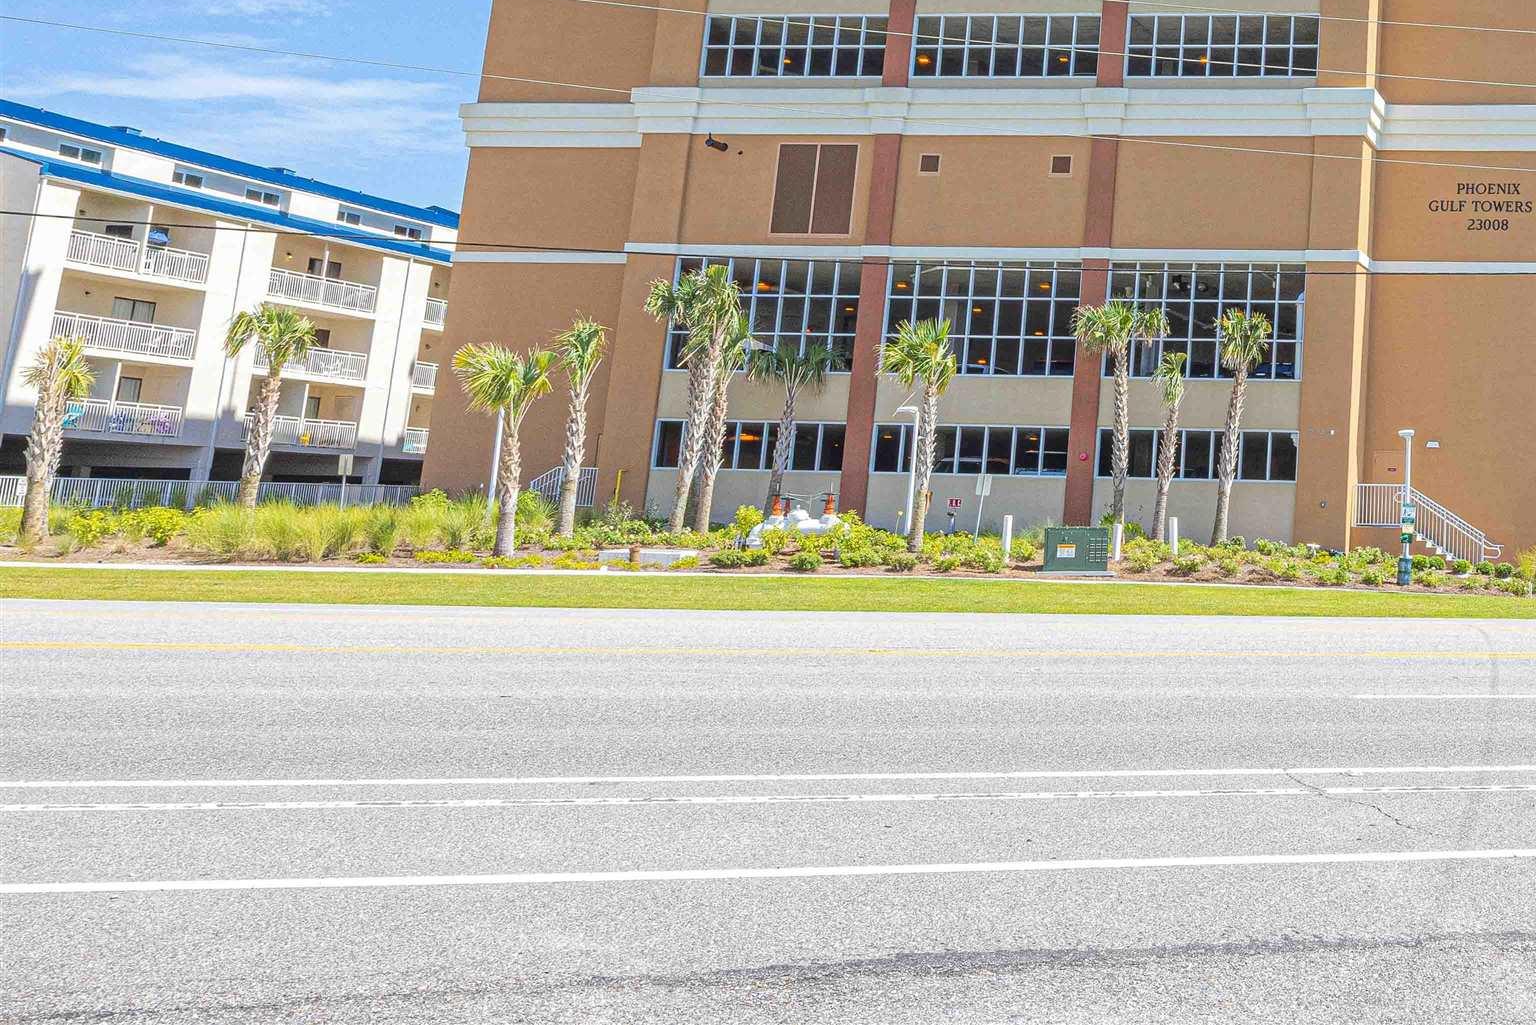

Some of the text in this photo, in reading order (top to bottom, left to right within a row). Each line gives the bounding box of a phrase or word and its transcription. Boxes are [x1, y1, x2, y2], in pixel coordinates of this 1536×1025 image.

[1456, 183, 1521, 195] PHOENIX
[1428, 200, 1467, 212] GULF
[1471, 200, 1533, 213] TOWERS
[1467, 219, 1509, 231] 23008
